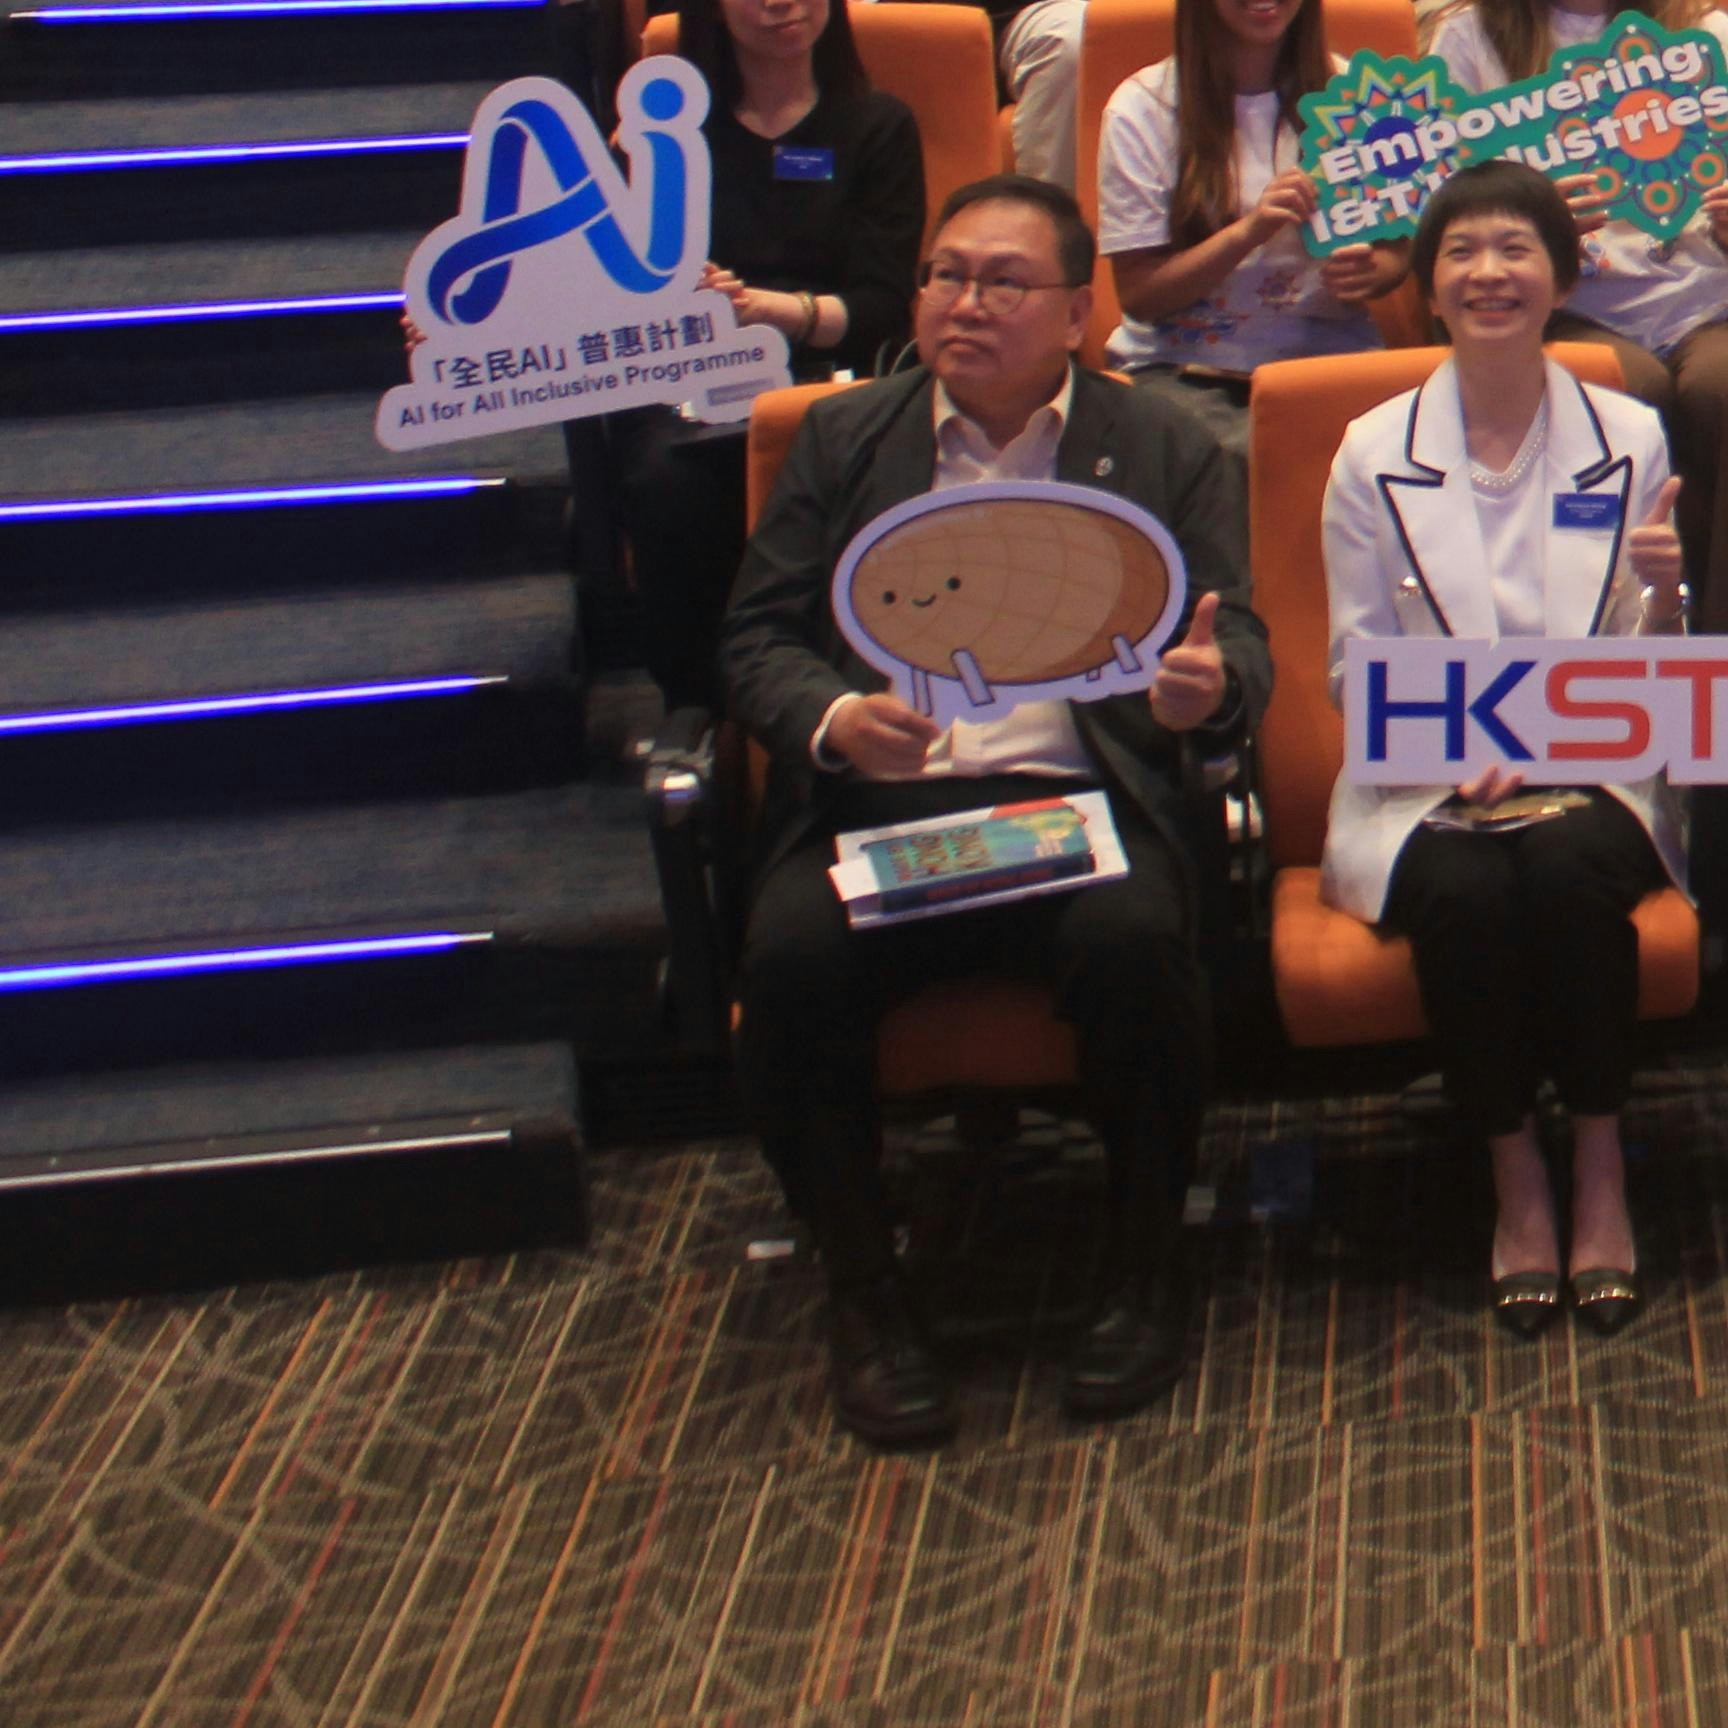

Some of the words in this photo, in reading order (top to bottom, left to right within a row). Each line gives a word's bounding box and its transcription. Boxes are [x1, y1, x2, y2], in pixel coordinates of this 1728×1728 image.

[1319, 41, 1706, 184] Empowering
[1310, 180, 1417, 242] I&T
[400, 405, 426, 429] AI
[431, 397, 467, 422] for
[473, 388, 506, 413] All
[511, 371, 620, 408] Inclusive
[625, 344, 767, 393] Programme
